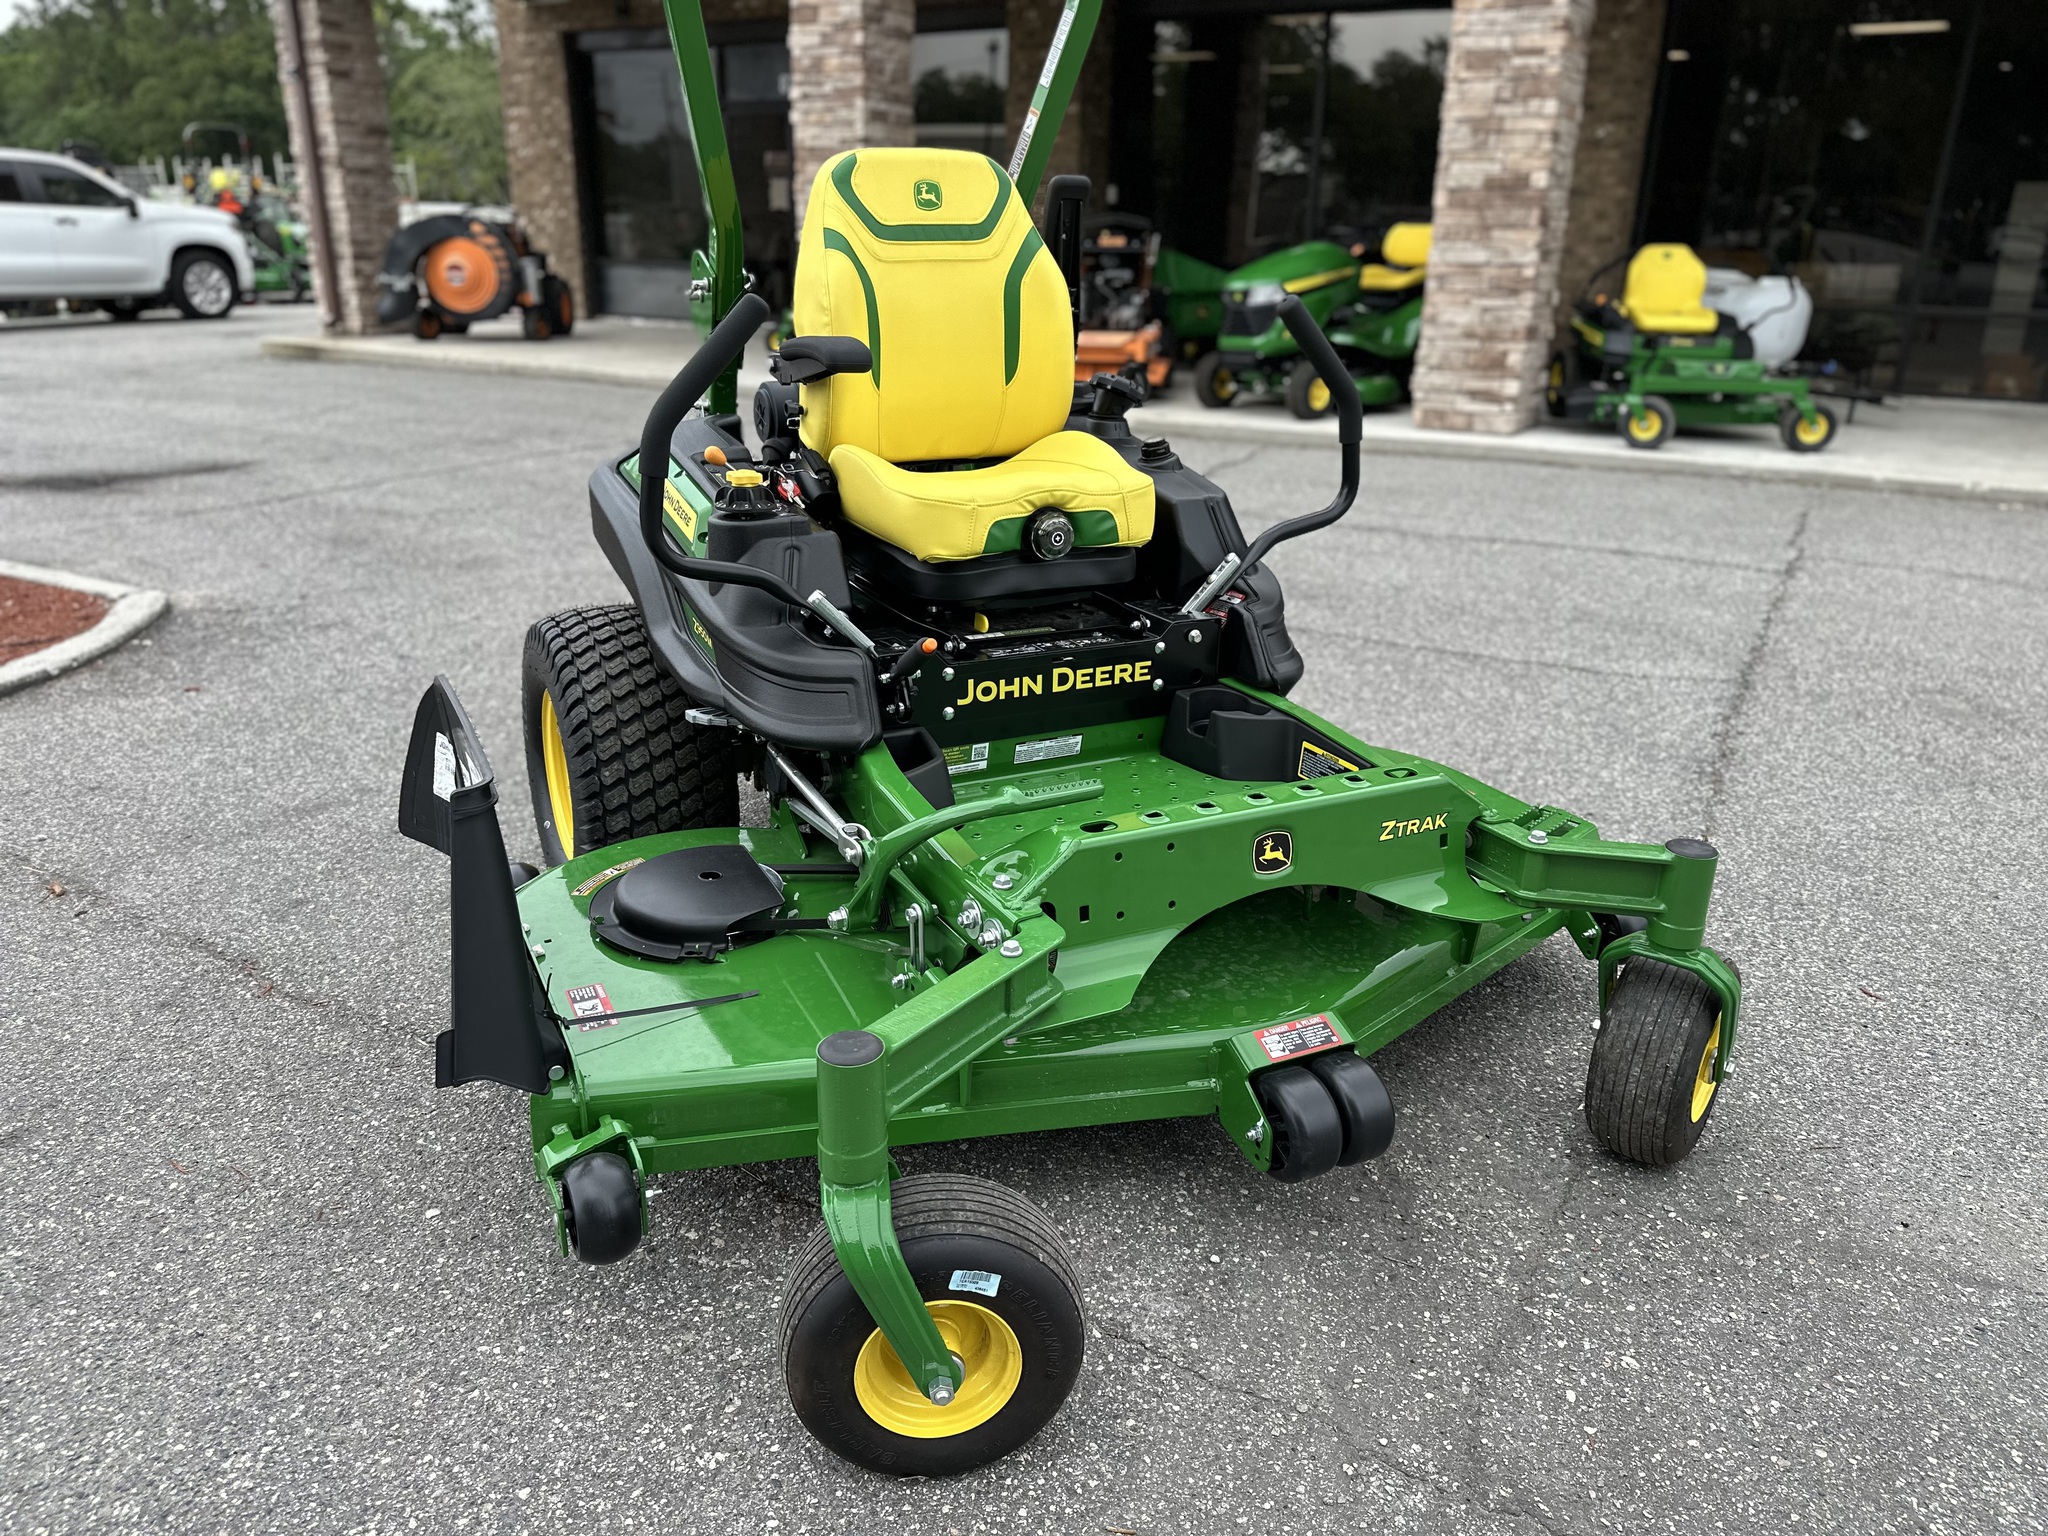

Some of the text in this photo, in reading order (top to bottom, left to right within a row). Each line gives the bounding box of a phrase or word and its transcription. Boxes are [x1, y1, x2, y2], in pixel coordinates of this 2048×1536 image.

[673, 499, 692, 528] DEERE
[957, 660, 1152, 706] JOHN DEERE
[1378, 811, 1449, 842] ZTRAK
